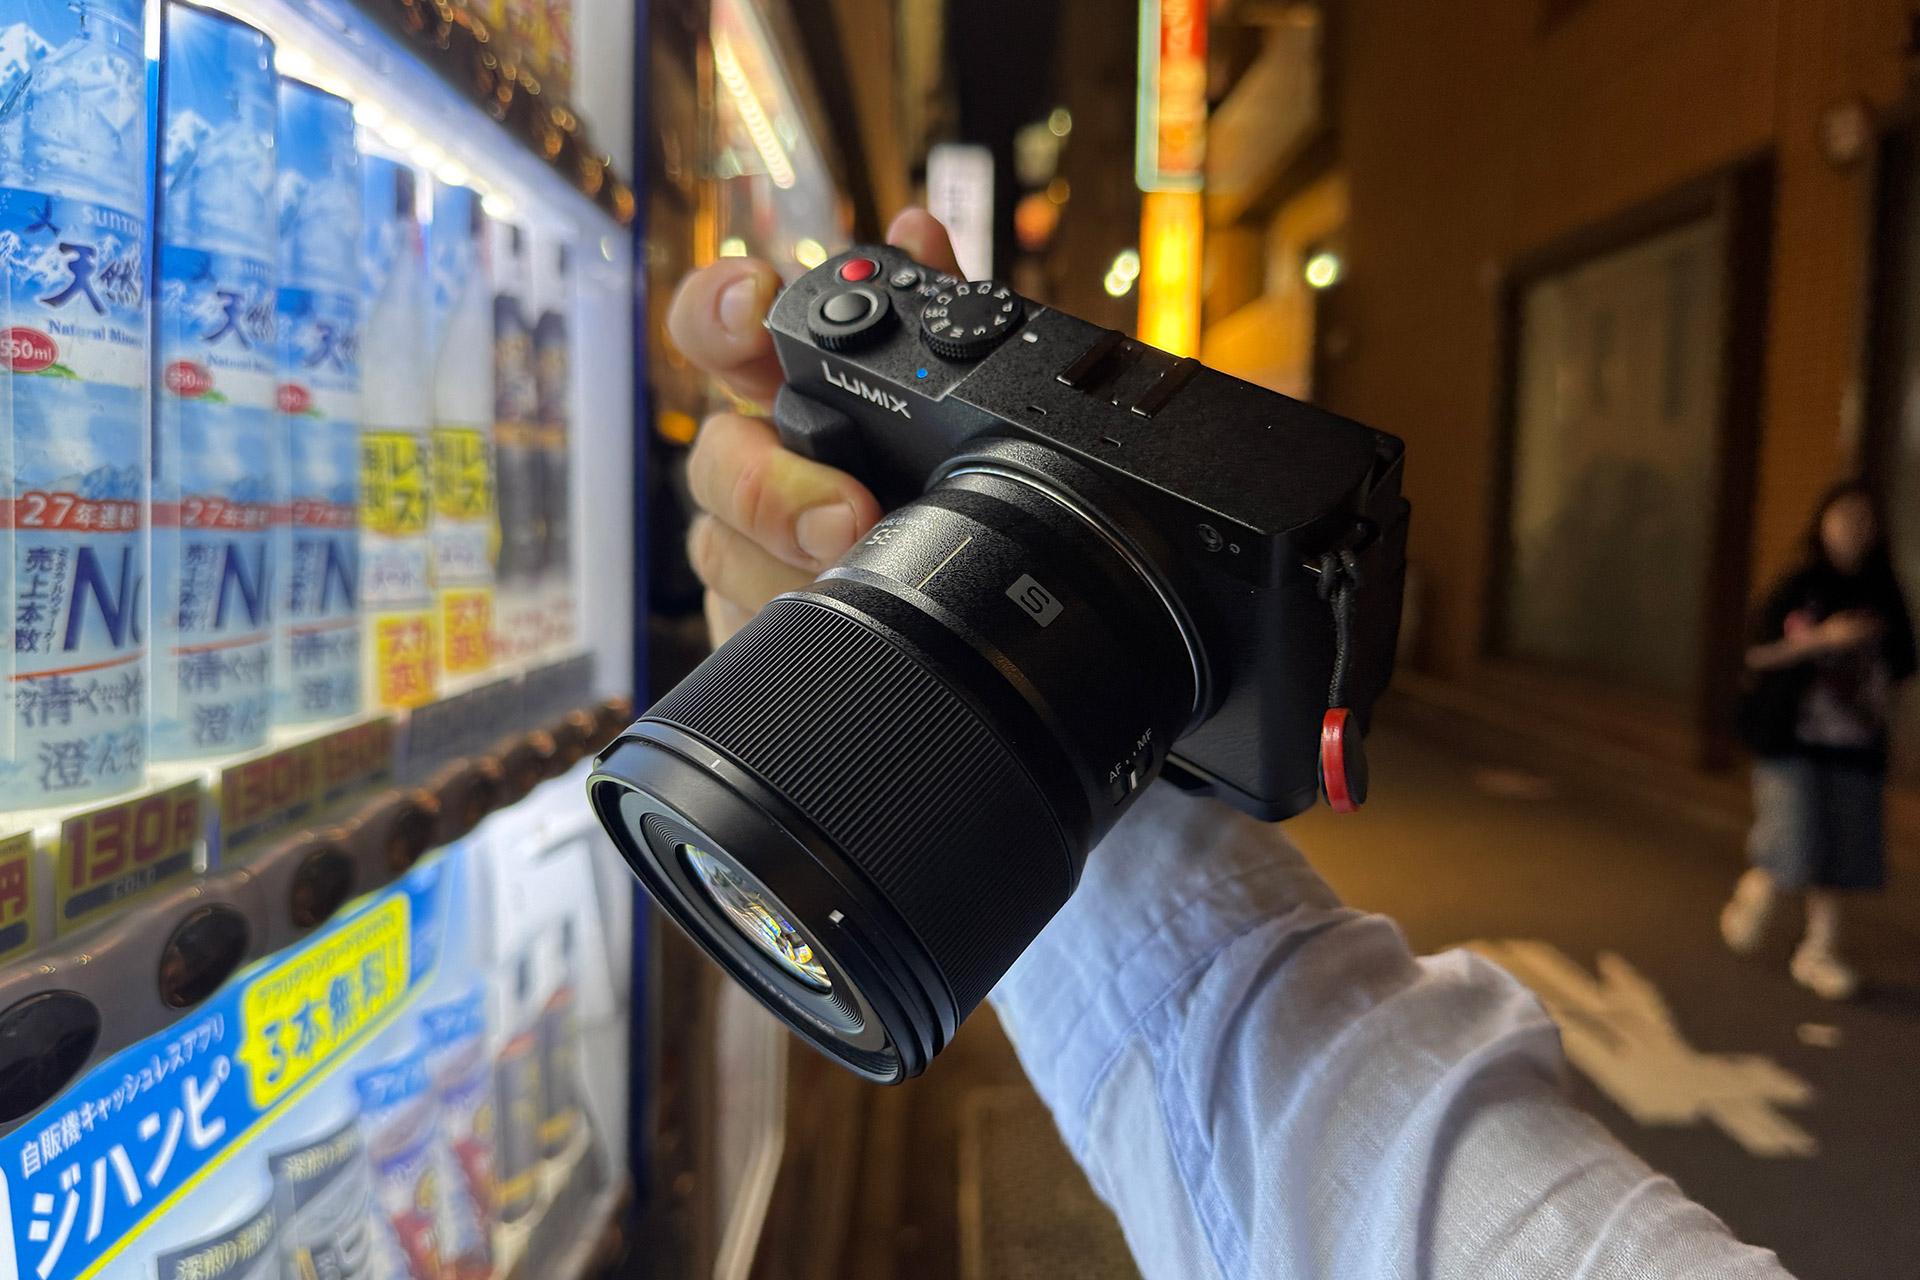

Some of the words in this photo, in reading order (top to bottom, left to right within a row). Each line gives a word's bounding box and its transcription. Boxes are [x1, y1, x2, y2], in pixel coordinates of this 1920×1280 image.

[925, 306, 948, 318] S&Q
[1002, 302, 1013, 312] P
[973, 326, 986, 336] S
[994, 314, 1007, 326] A
[822, 360, 911, 419] LUMIX
[1020, 586, 1050, 614] S
[1137, 727, 1152, 750] MF
[1109, 762, 1122, 783] AF
[19, 1012, 226, 1181] 自販機キャッシュレスアプリ
[27, 1054, 232, 1280] ジハンピ
